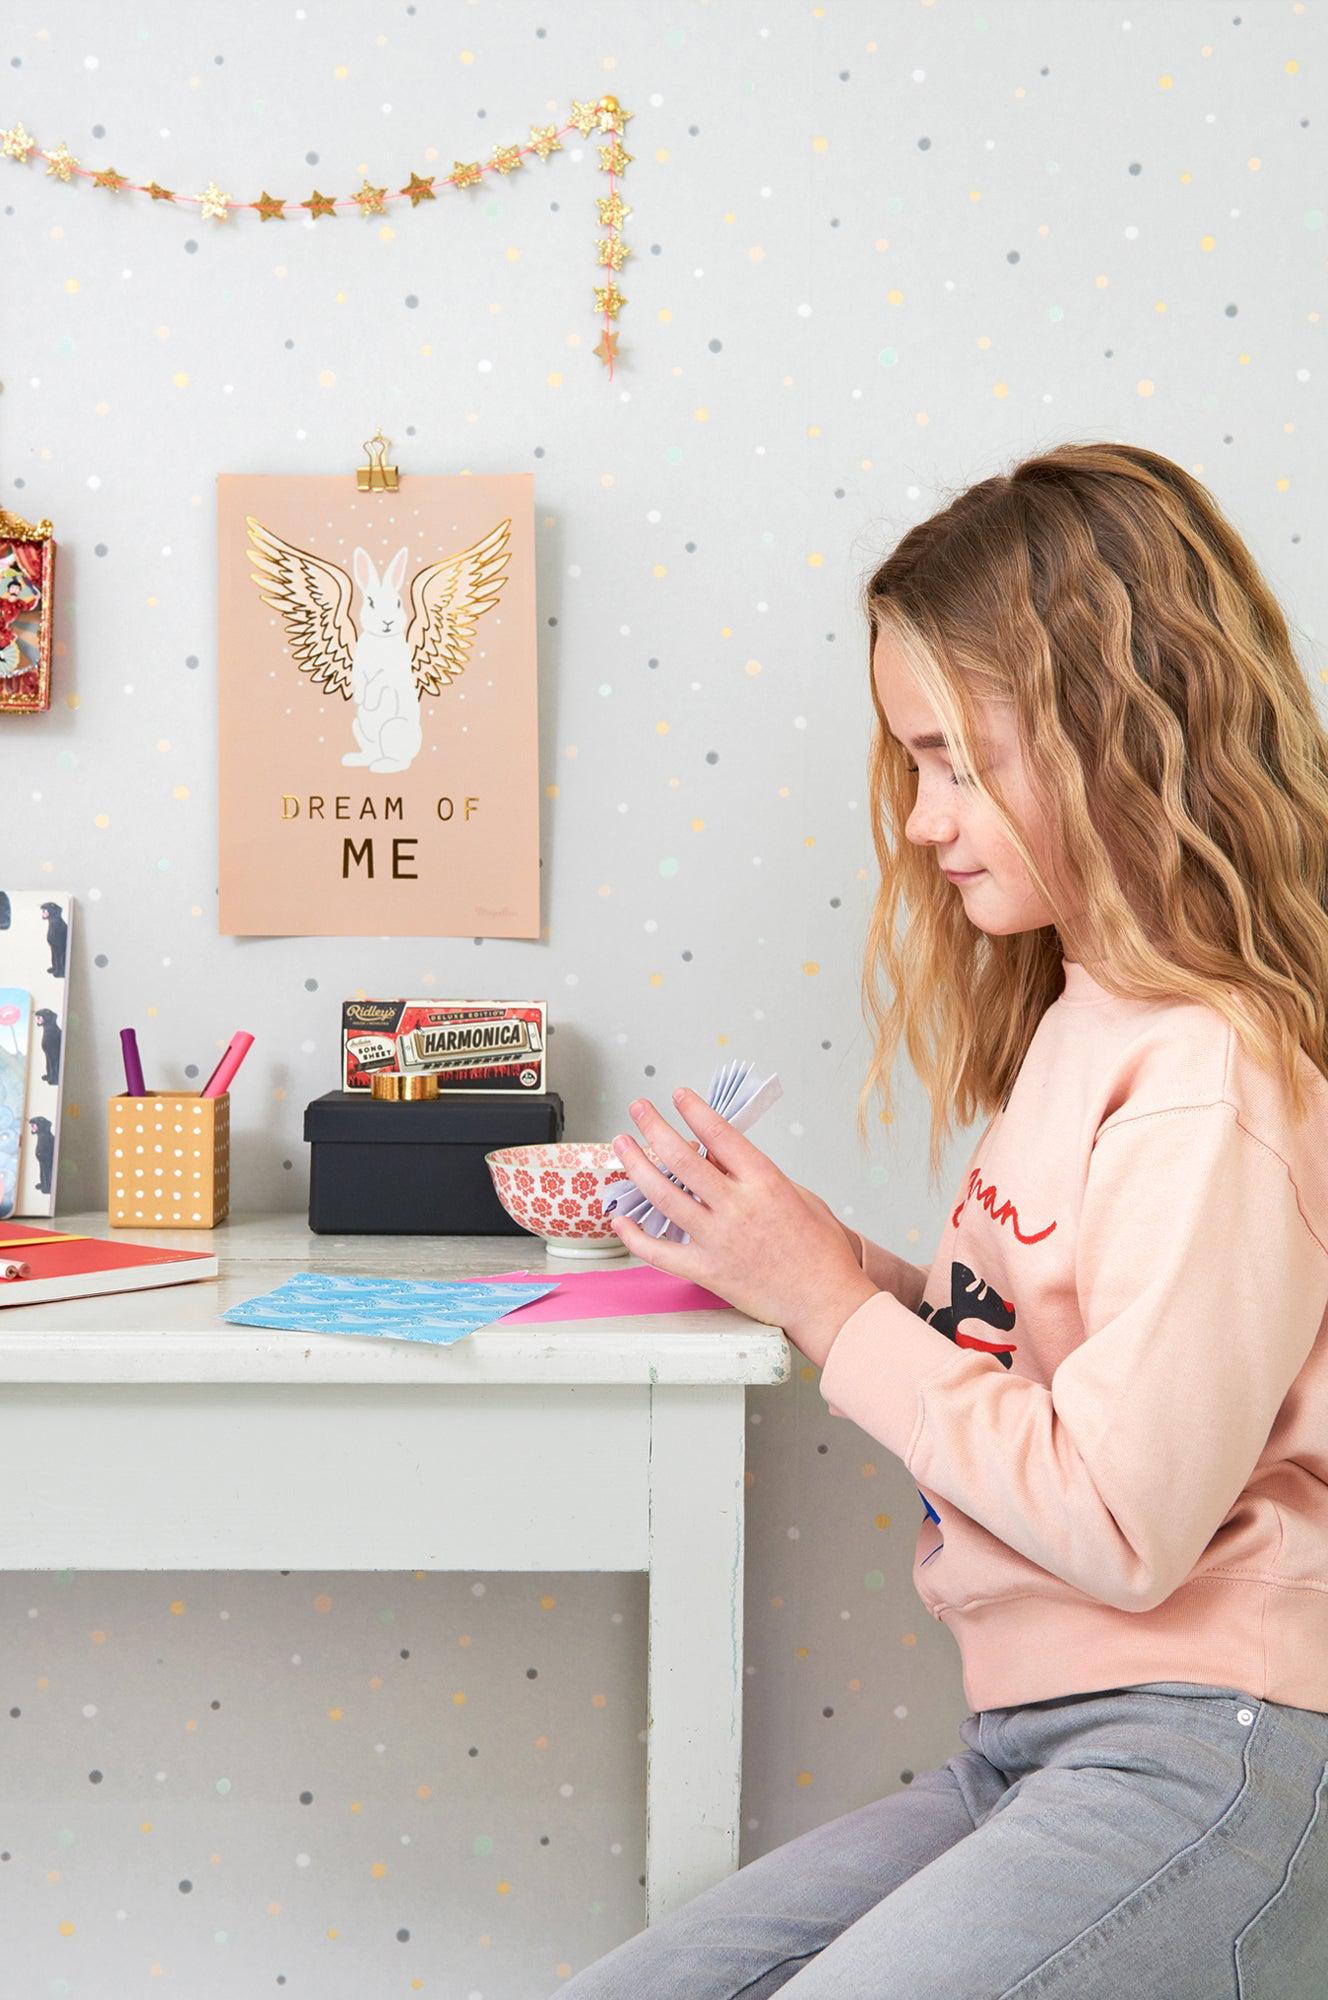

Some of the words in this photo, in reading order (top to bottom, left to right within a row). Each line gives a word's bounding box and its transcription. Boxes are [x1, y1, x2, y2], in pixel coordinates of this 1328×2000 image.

[281, 795, 403, 821] DREAM
[437, 797, 481, 822] OF
[342, 838, 418, 879] ME
[346, 1004, 397, 1021] Ridley's
[431, 1013, 466, 1021] DELUXE
[468, 1010, 504, 1019] EDITION
[425, 1024, 520, 1053] HARMONICA
[358, 1044, 383, 1054] SONG
[363, 1050, 391, 1060] SHEET
